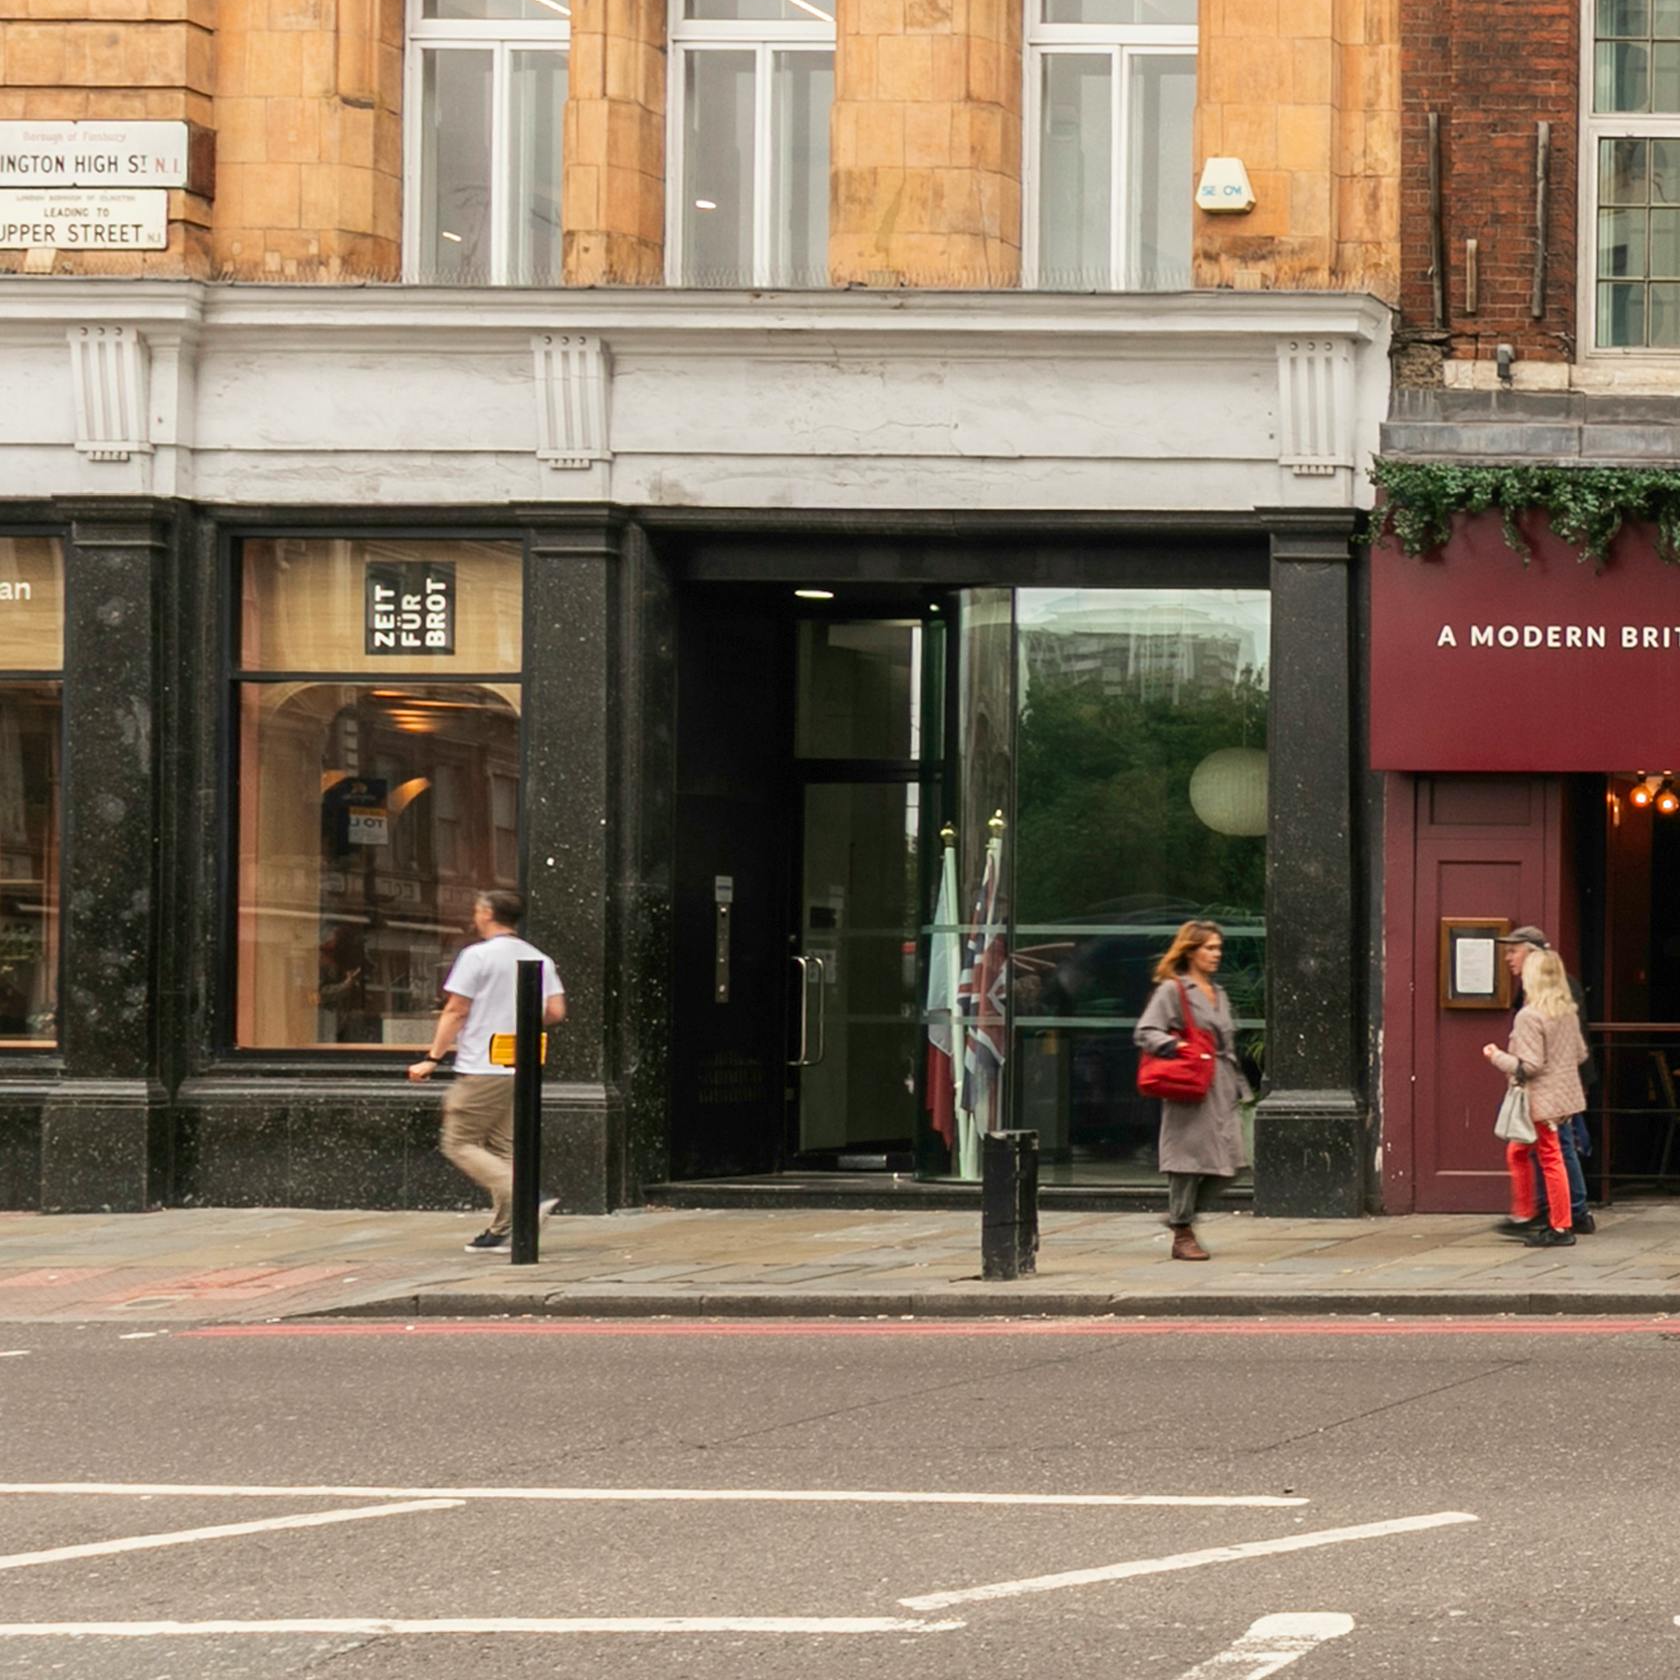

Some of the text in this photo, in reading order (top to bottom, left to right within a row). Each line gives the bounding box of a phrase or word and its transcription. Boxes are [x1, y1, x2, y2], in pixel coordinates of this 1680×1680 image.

[75, 154, 118, 174] HIGH
[43, 207, 110, 219] LEADING TO
[68, 224, 144, 243] STREET
[374, 584, 396, 647] ZEIT
[396, 594, 422, 647] FÜR
[425, 577, 447, 647] BROT
[1437, 624, 1457, 647] A
[1470, 624, 1606, 648] MODERN
